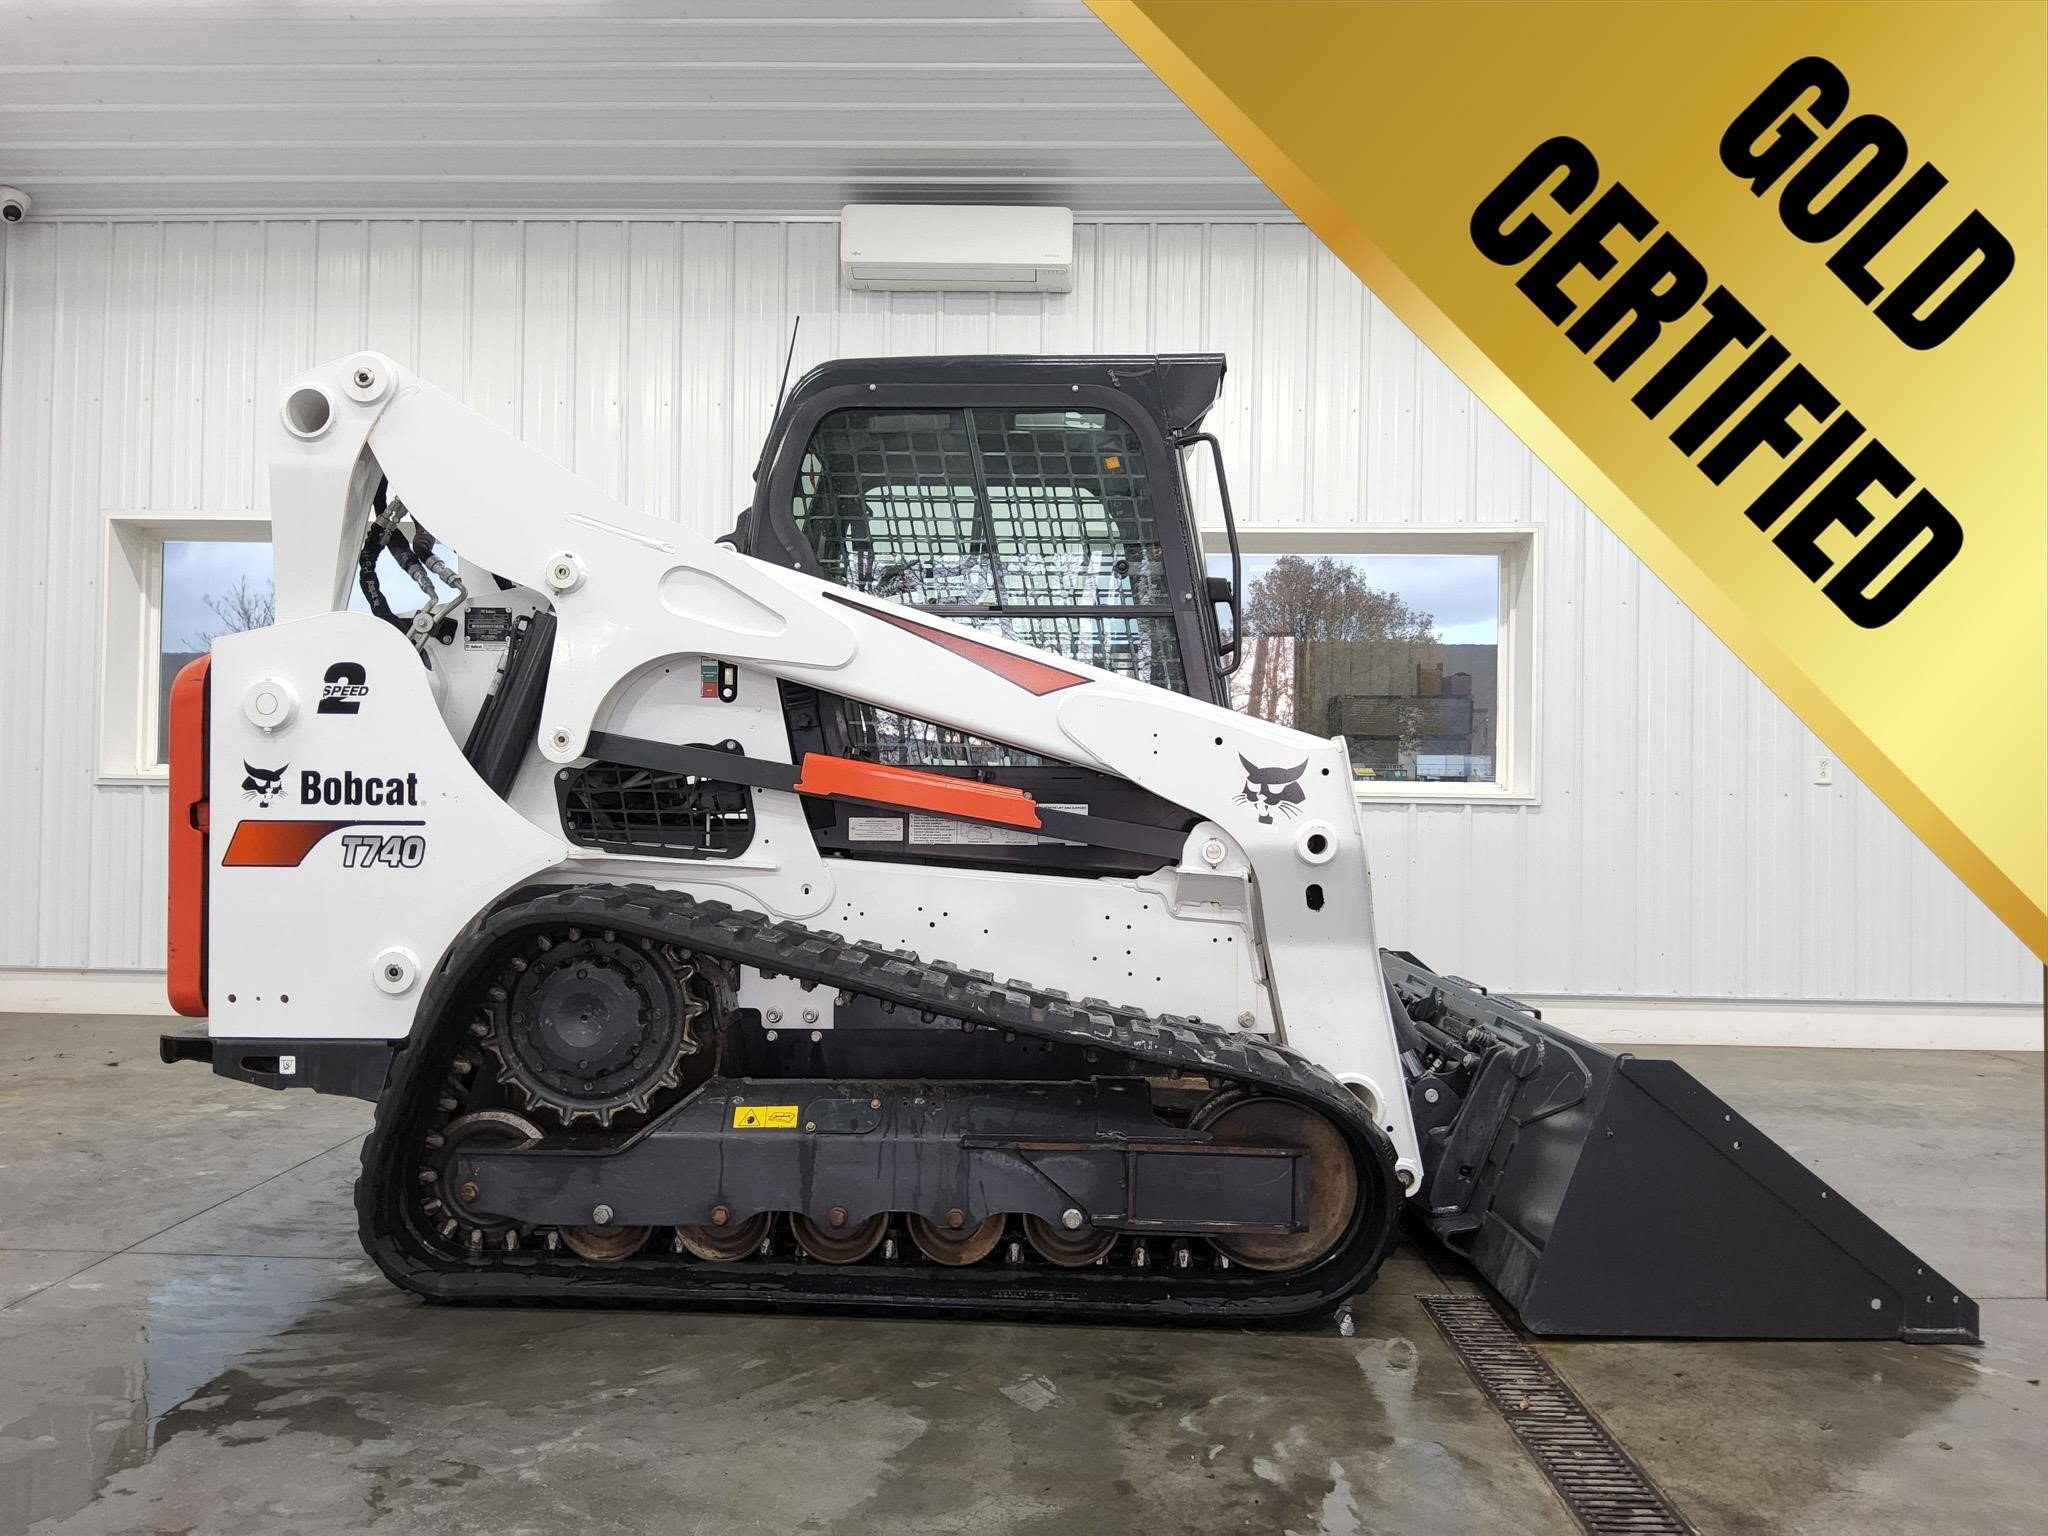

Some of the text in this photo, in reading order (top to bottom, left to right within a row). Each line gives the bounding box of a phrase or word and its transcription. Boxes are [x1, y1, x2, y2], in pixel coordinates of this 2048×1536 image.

[317, 662, 366, 714] 2
[323, 686, 369, 697] SPEED
[301, 771, 418, 806] Bobcat
[341, 835, 426, 868] T740
